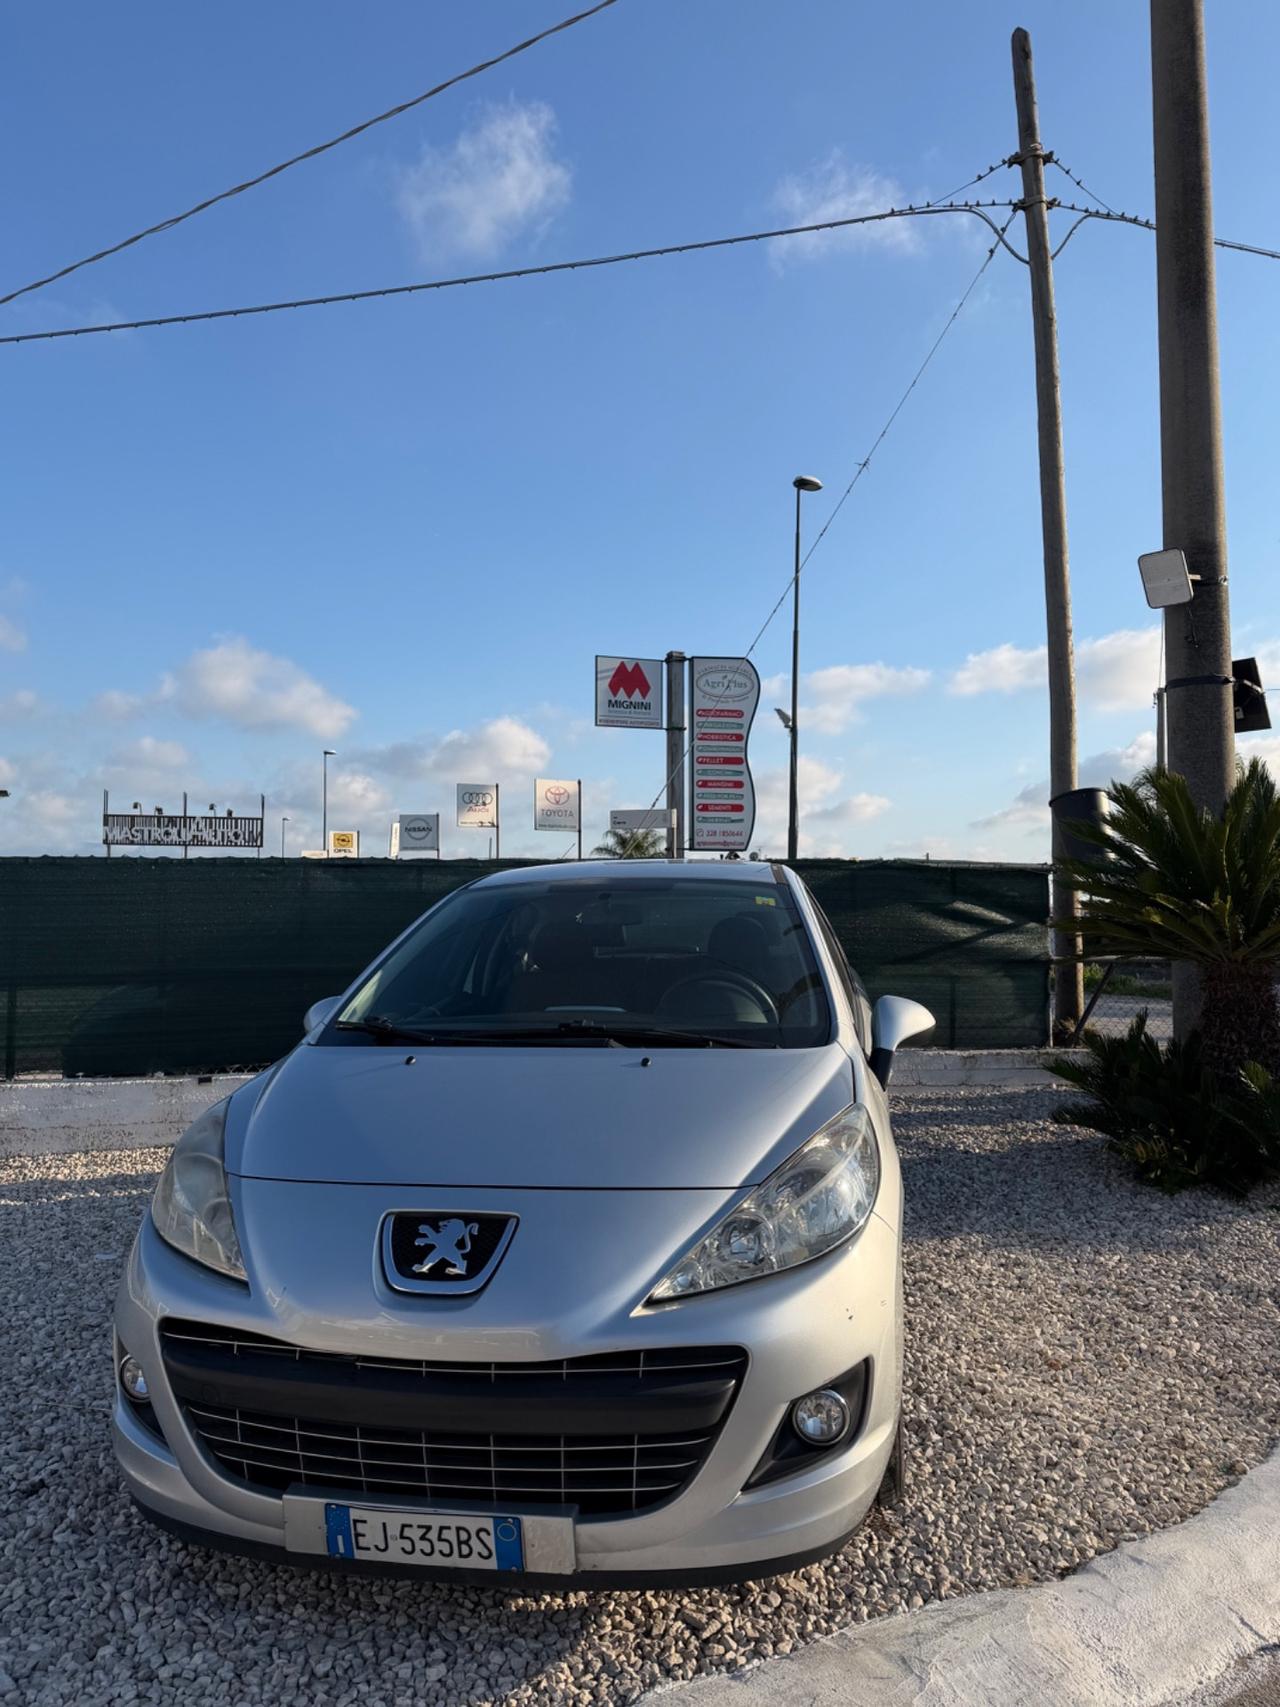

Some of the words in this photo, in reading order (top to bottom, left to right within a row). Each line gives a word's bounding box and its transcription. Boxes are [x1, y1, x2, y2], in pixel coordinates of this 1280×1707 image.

[703, 679, 725, 689] Agri
[726, 679, 748, 691] Plus
[607, 699, 651, 711] MIGNINI
[541, 809, 575, 818] TOYOTA
[399, 1523, 494, 1560] 535BS
